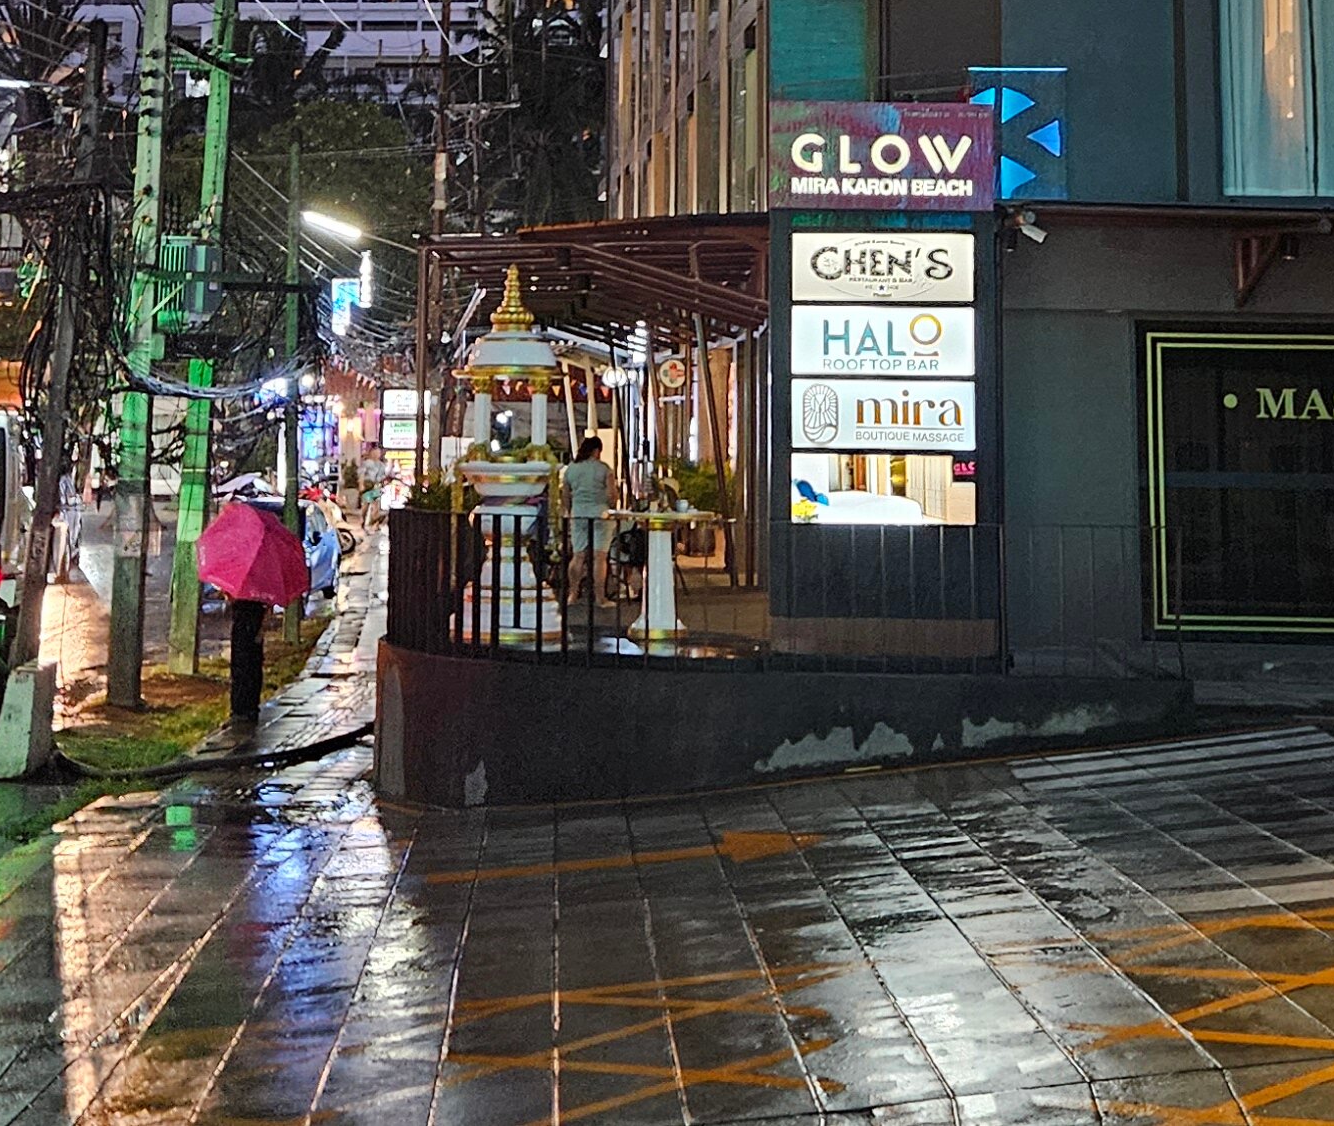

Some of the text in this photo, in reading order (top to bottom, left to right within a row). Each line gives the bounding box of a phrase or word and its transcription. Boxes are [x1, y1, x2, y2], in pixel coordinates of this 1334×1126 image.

[791, 133, 972, 174] GLOW
[791, 177, 973, 197] MIRA KARON BEACH
[810, 246, 953, 280] CHEN'S
[823, 313, 942, 357] HALO
[823, 359, 939, 371] ROOFTOP BAR
[856, 389, 962, 426] mira
[855, 431, 965, 443] BOUTIQUE MASSAGE
